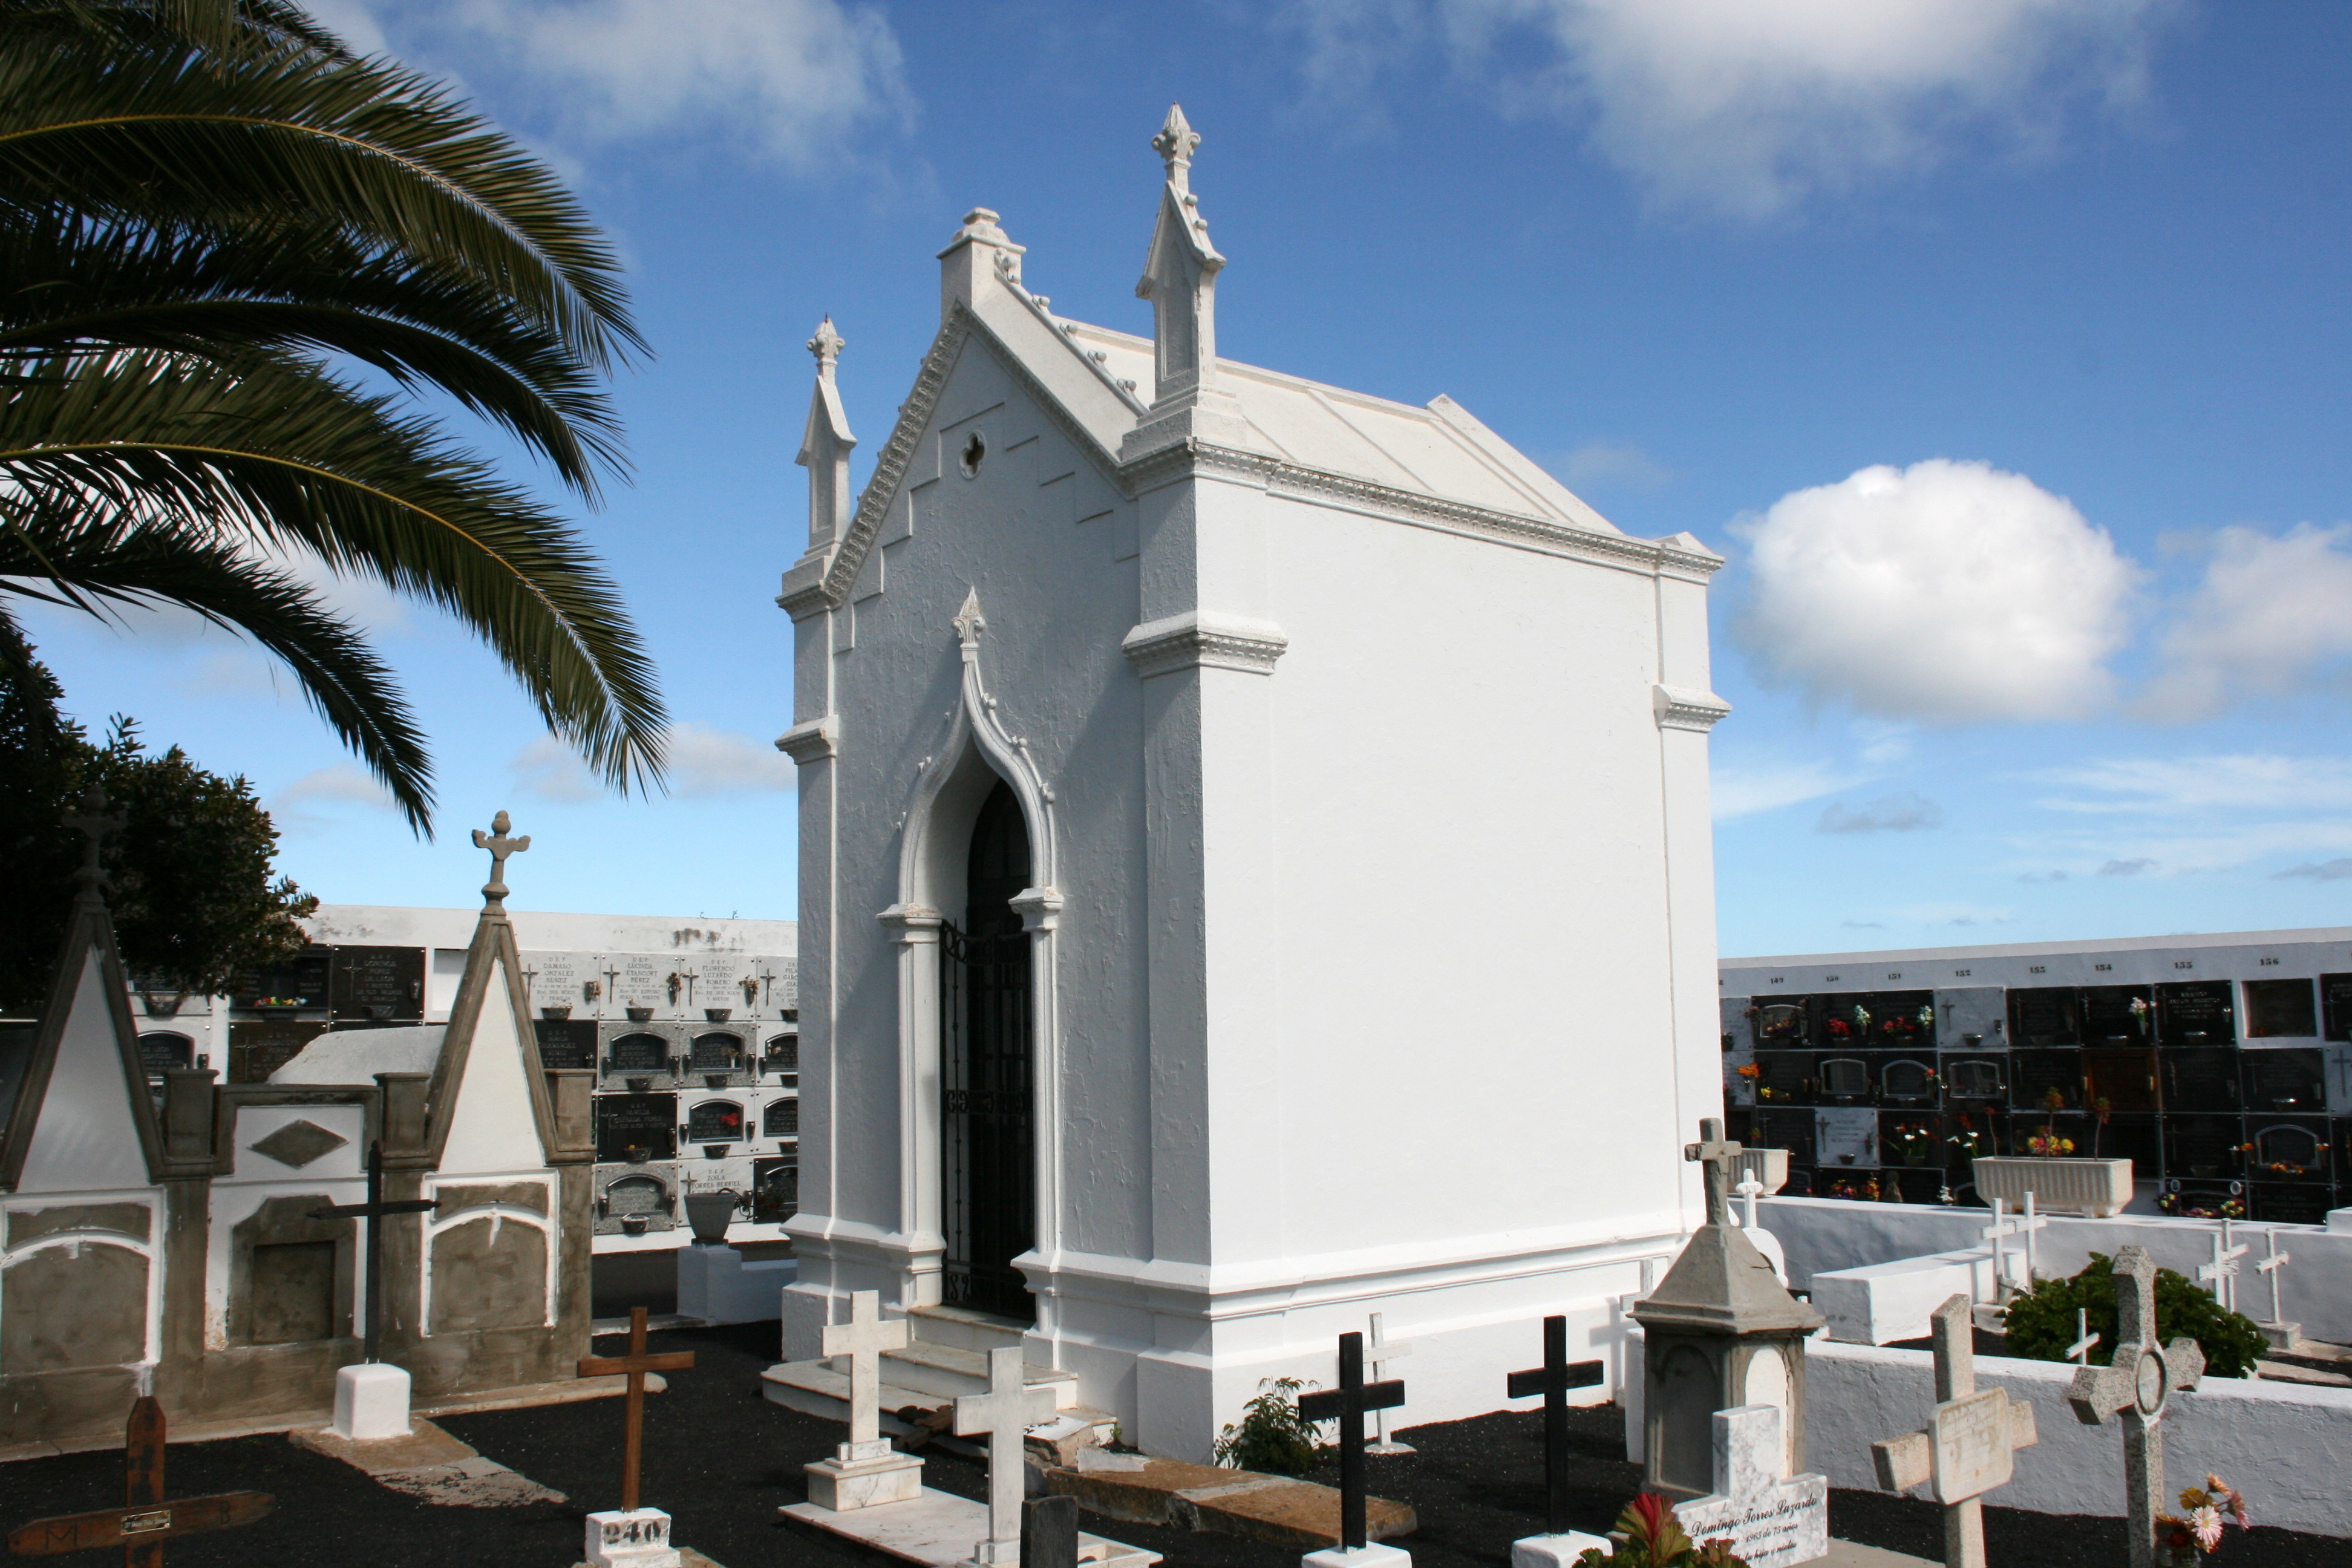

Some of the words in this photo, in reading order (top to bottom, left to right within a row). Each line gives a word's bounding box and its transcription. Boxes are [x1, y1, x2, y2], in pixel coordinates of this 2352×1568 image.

[220, 1501, 230, 1525] B
[1692, 1517, 1741, 1537] Domingo
[1742, 1508, 1775, 1524] Torres
[1776, 1493, 1818, 1518] Luzardo
[45, 1523, 77, 1549] M
[606, 1521, 661, 1544] 240
[1763, 1527, 1771, 1538] de
[1773, 1526, 1782, 1536] 75
[1782, 1522, 1798, 1533] años
